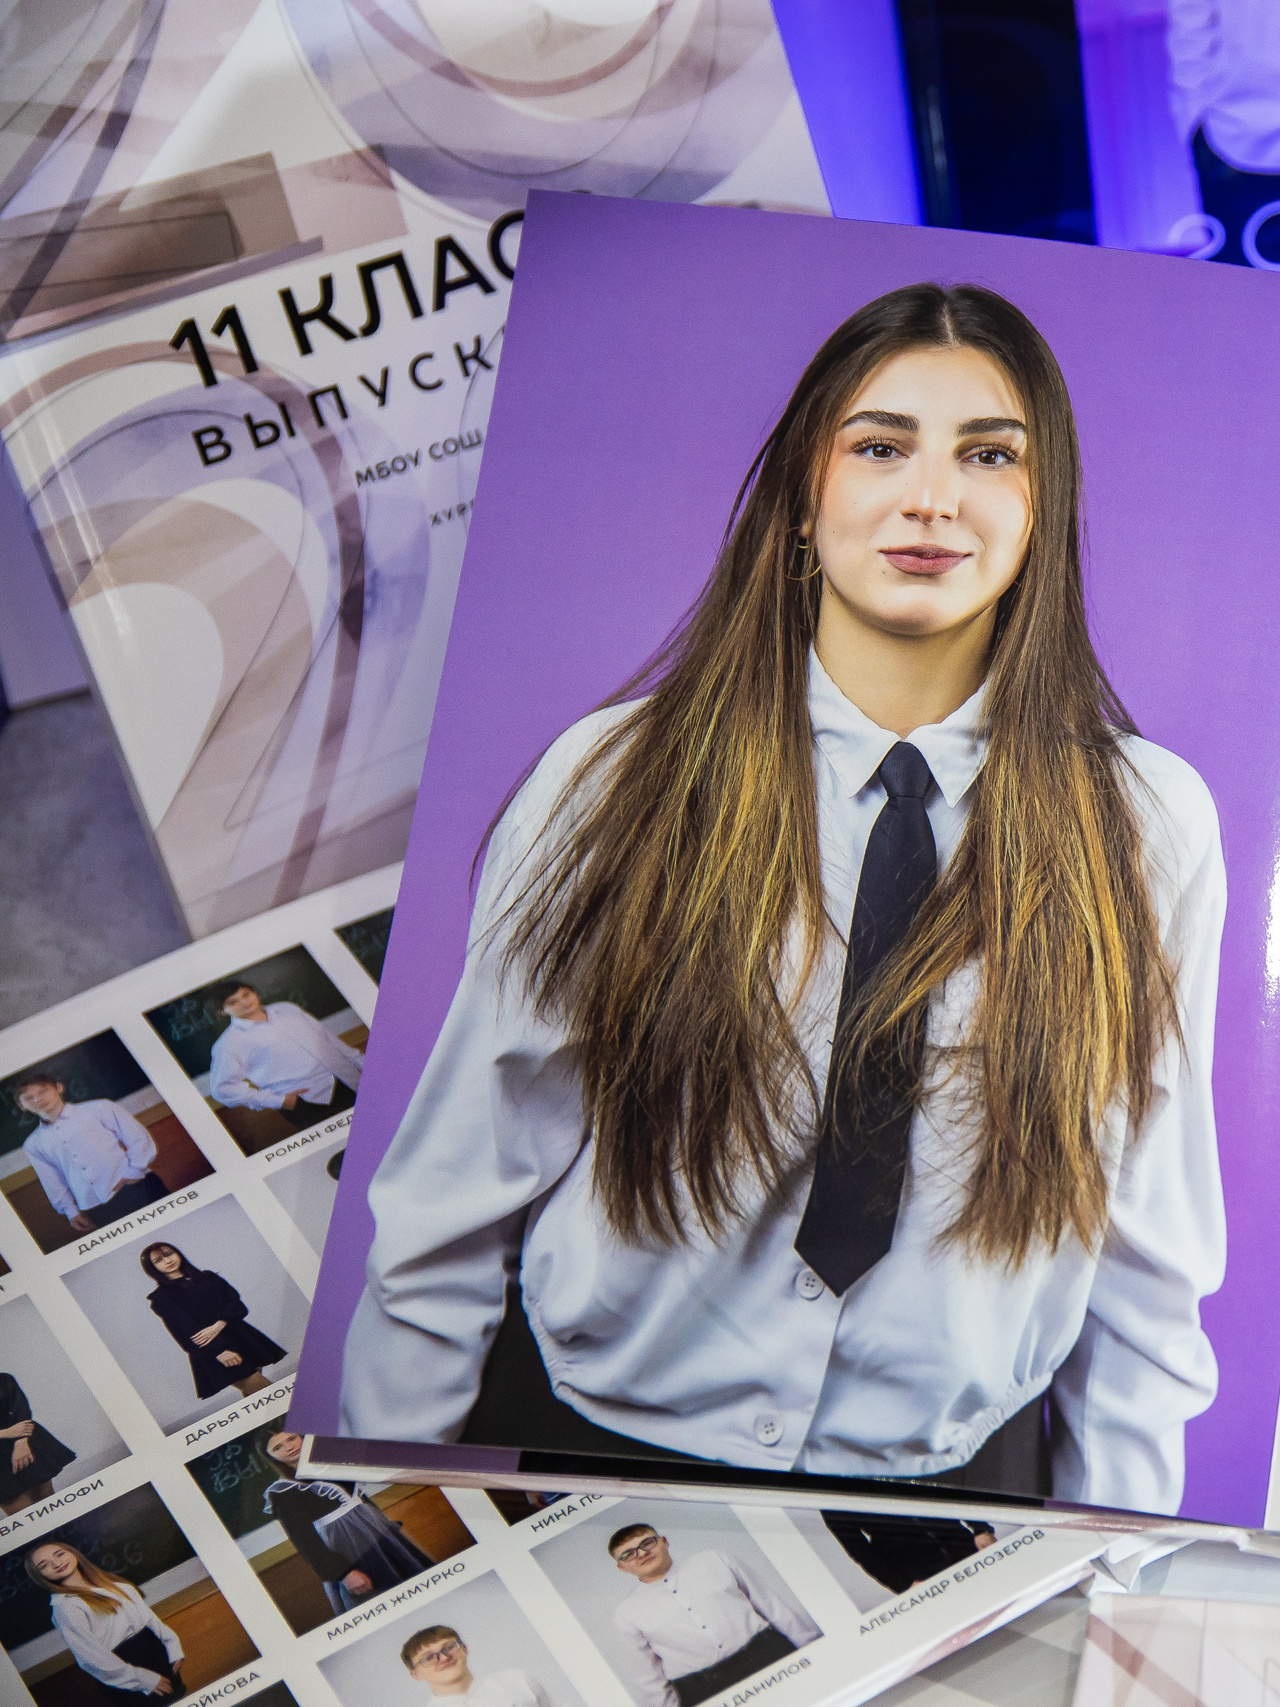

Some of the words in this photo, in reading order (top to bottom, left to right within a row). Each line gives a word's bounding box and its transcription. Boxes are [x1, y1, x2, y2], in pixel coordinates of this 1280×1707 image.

[168, 305, 259, 390] 11
[191, 322, 506, 468] ВЫПУСК
[355, 448, 420, 488] МБОУ
[428, 427, 483, 462] СОШ
[264, 1131, 321, 1163] РОМАН
[77, 1221, 134, 1256] ДАНИЛ
[136, 1190, 199, 1225] КУРТОВ
[184, 1411, 240, 1446] ДАРЬЯ
[25, 1478, 104, 1522] ТИМОФИ
[530, 1504, 578, 1533] НИНА
[326, 1602, 388, 1641] МАРИЯ
[389, 1562, 466, 1608] ЖМУРКО
[859, 1578, 950, 1637] АЛЕКСАНДР
[952, 1529, 1045, 1584] БЕЛОЗЕРОВ
[732, 1658, 811, 1707] ДАНИЛОВ
